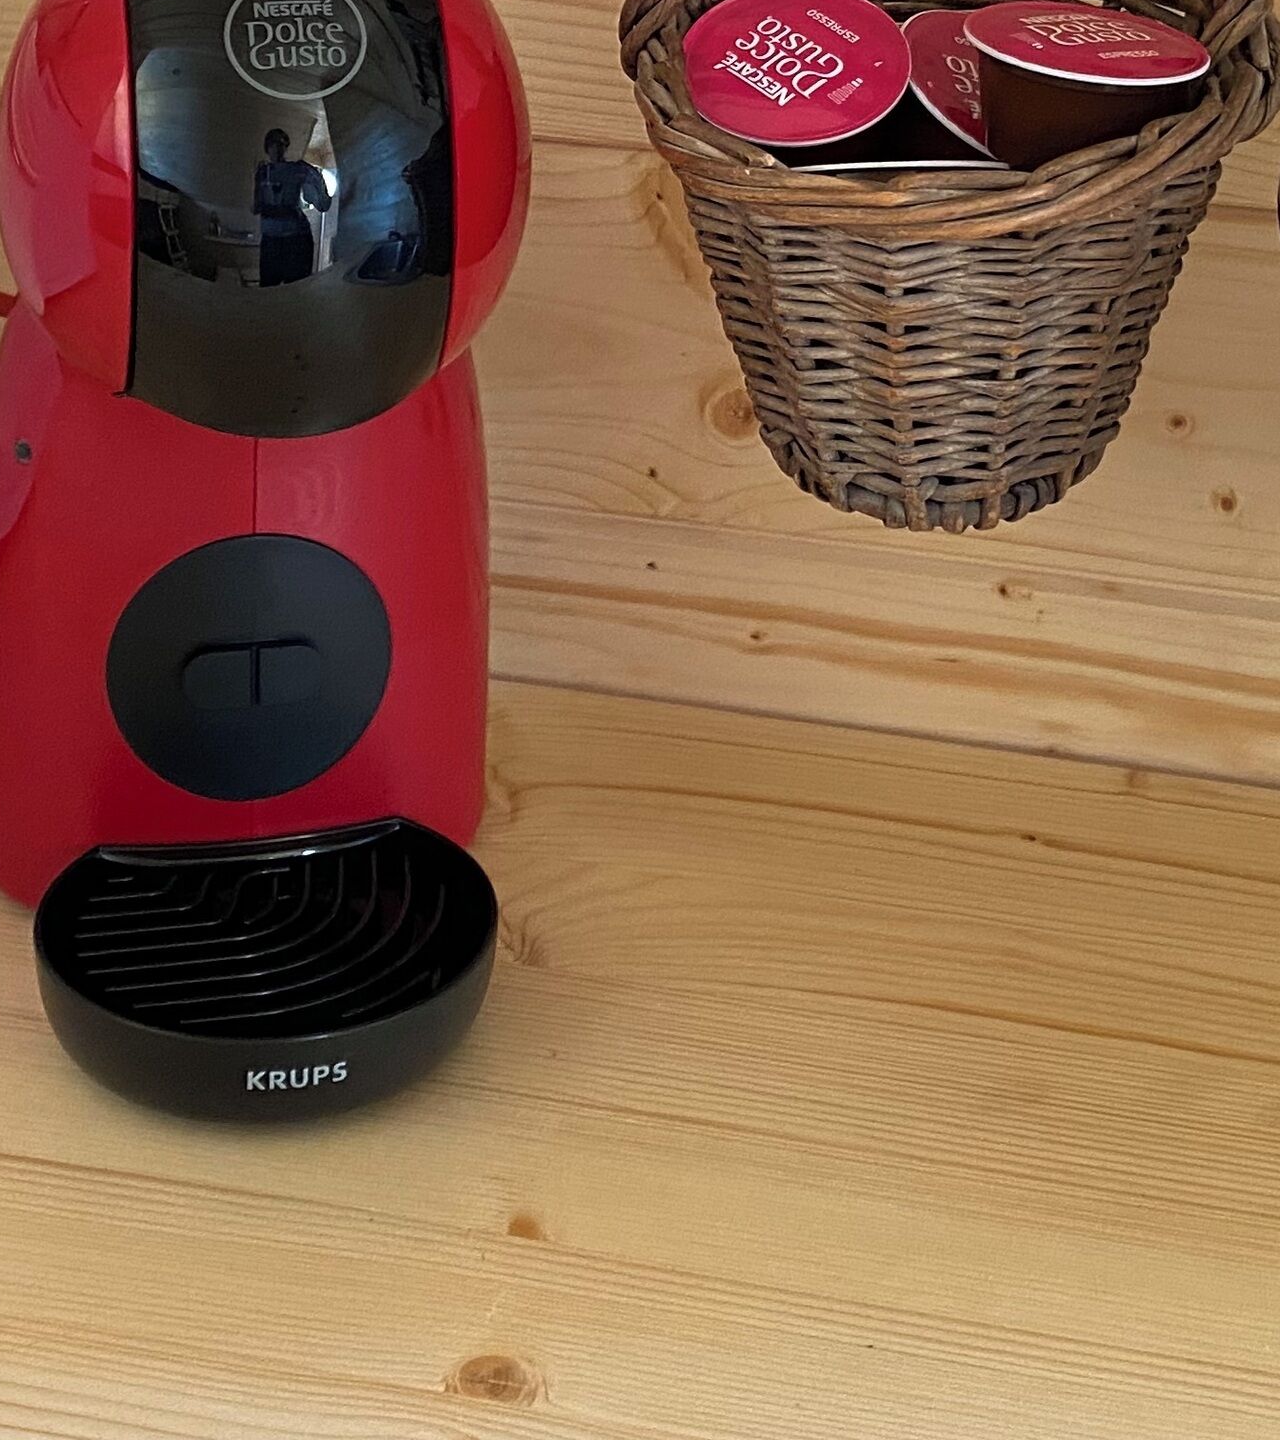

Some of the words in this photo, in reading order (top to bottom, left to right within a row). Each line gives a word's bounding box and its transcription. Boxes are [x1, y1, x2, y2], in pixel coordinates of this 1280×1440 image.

[244, 18, 344, 47] Dolce
[806, 9, 861, 44] ESPRESSO
[1024, 20, 1134, 36] Dolce
[1049, 30, 1154, 46] Gusto
[249, 40, 347, 70] Gusto
[756, 16, 844, 78] Gusto
[713, 51, 796, 106] NESCAFÉ
[734, 31, 828, 99] Dolce
[246, 1061, 348, 1091] KRUPS
